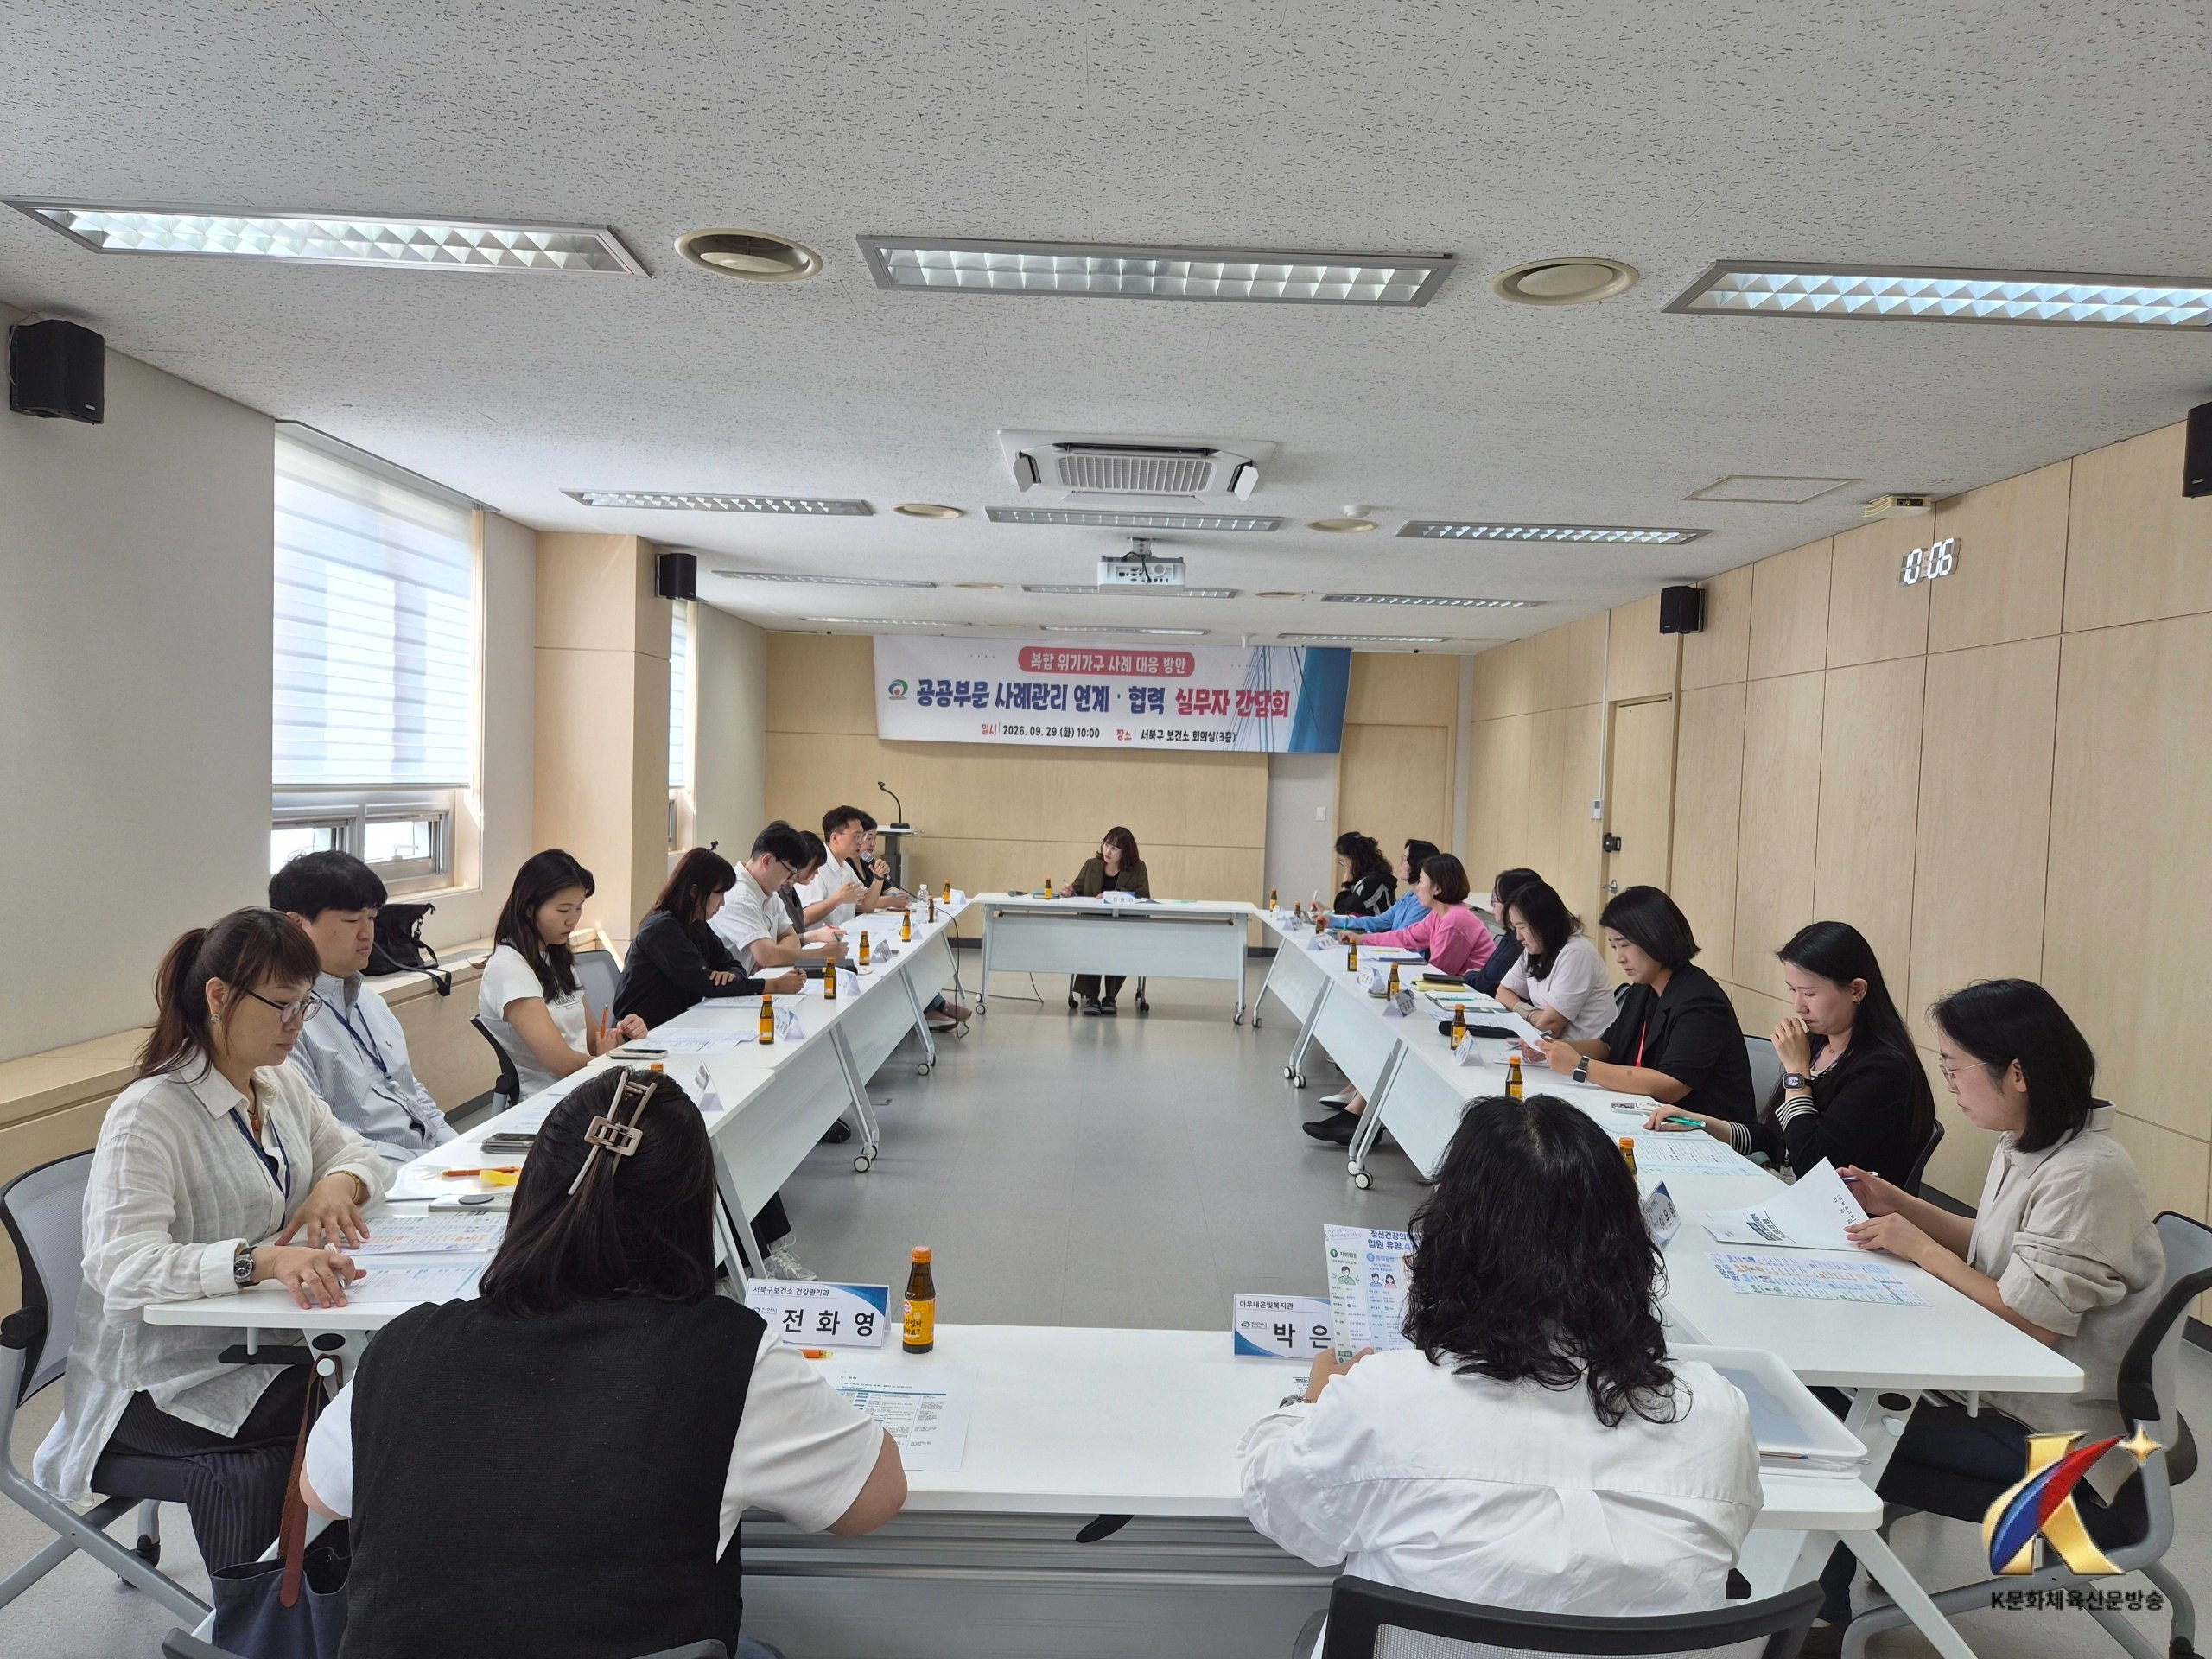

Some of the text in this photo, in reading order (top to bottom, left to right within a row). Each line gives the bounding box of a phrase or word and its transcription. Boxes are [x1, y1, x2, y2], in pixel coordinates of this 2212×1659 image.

[1031, 652, 1186, 675] 복합 위기가구 사례 대응 방안
[917, 678, 989, 709] 공공부문
[995, 681, 1068, 711] 사례관리
[1073, 683, 1110, 713] 연계
[1128, 685, 1166, 715] 협력
[1175, 687, 1230, 717] 실무자
[1235, 689, 1290, 718] 간담회
[1002, 725, 1027, 736] 2026.
[1077, 728, 1100, 739] 10:00
[1116, 728, 1132, 741] 장소
[1141, 728, 1164, 741] 서북구
[1166, 729, 1190, 741] 보건소
[1192, 730, 1236, 743] 회의실(3층)
[1367, 1238, 1384, 1249] 입원
[1386, 1241, 1402, 1250] 유형
[753, 1286, 830, 1297] 서북구보건소 건강관리과
[1239, 1300, 1294, 1310] 아우내은빛복지관
